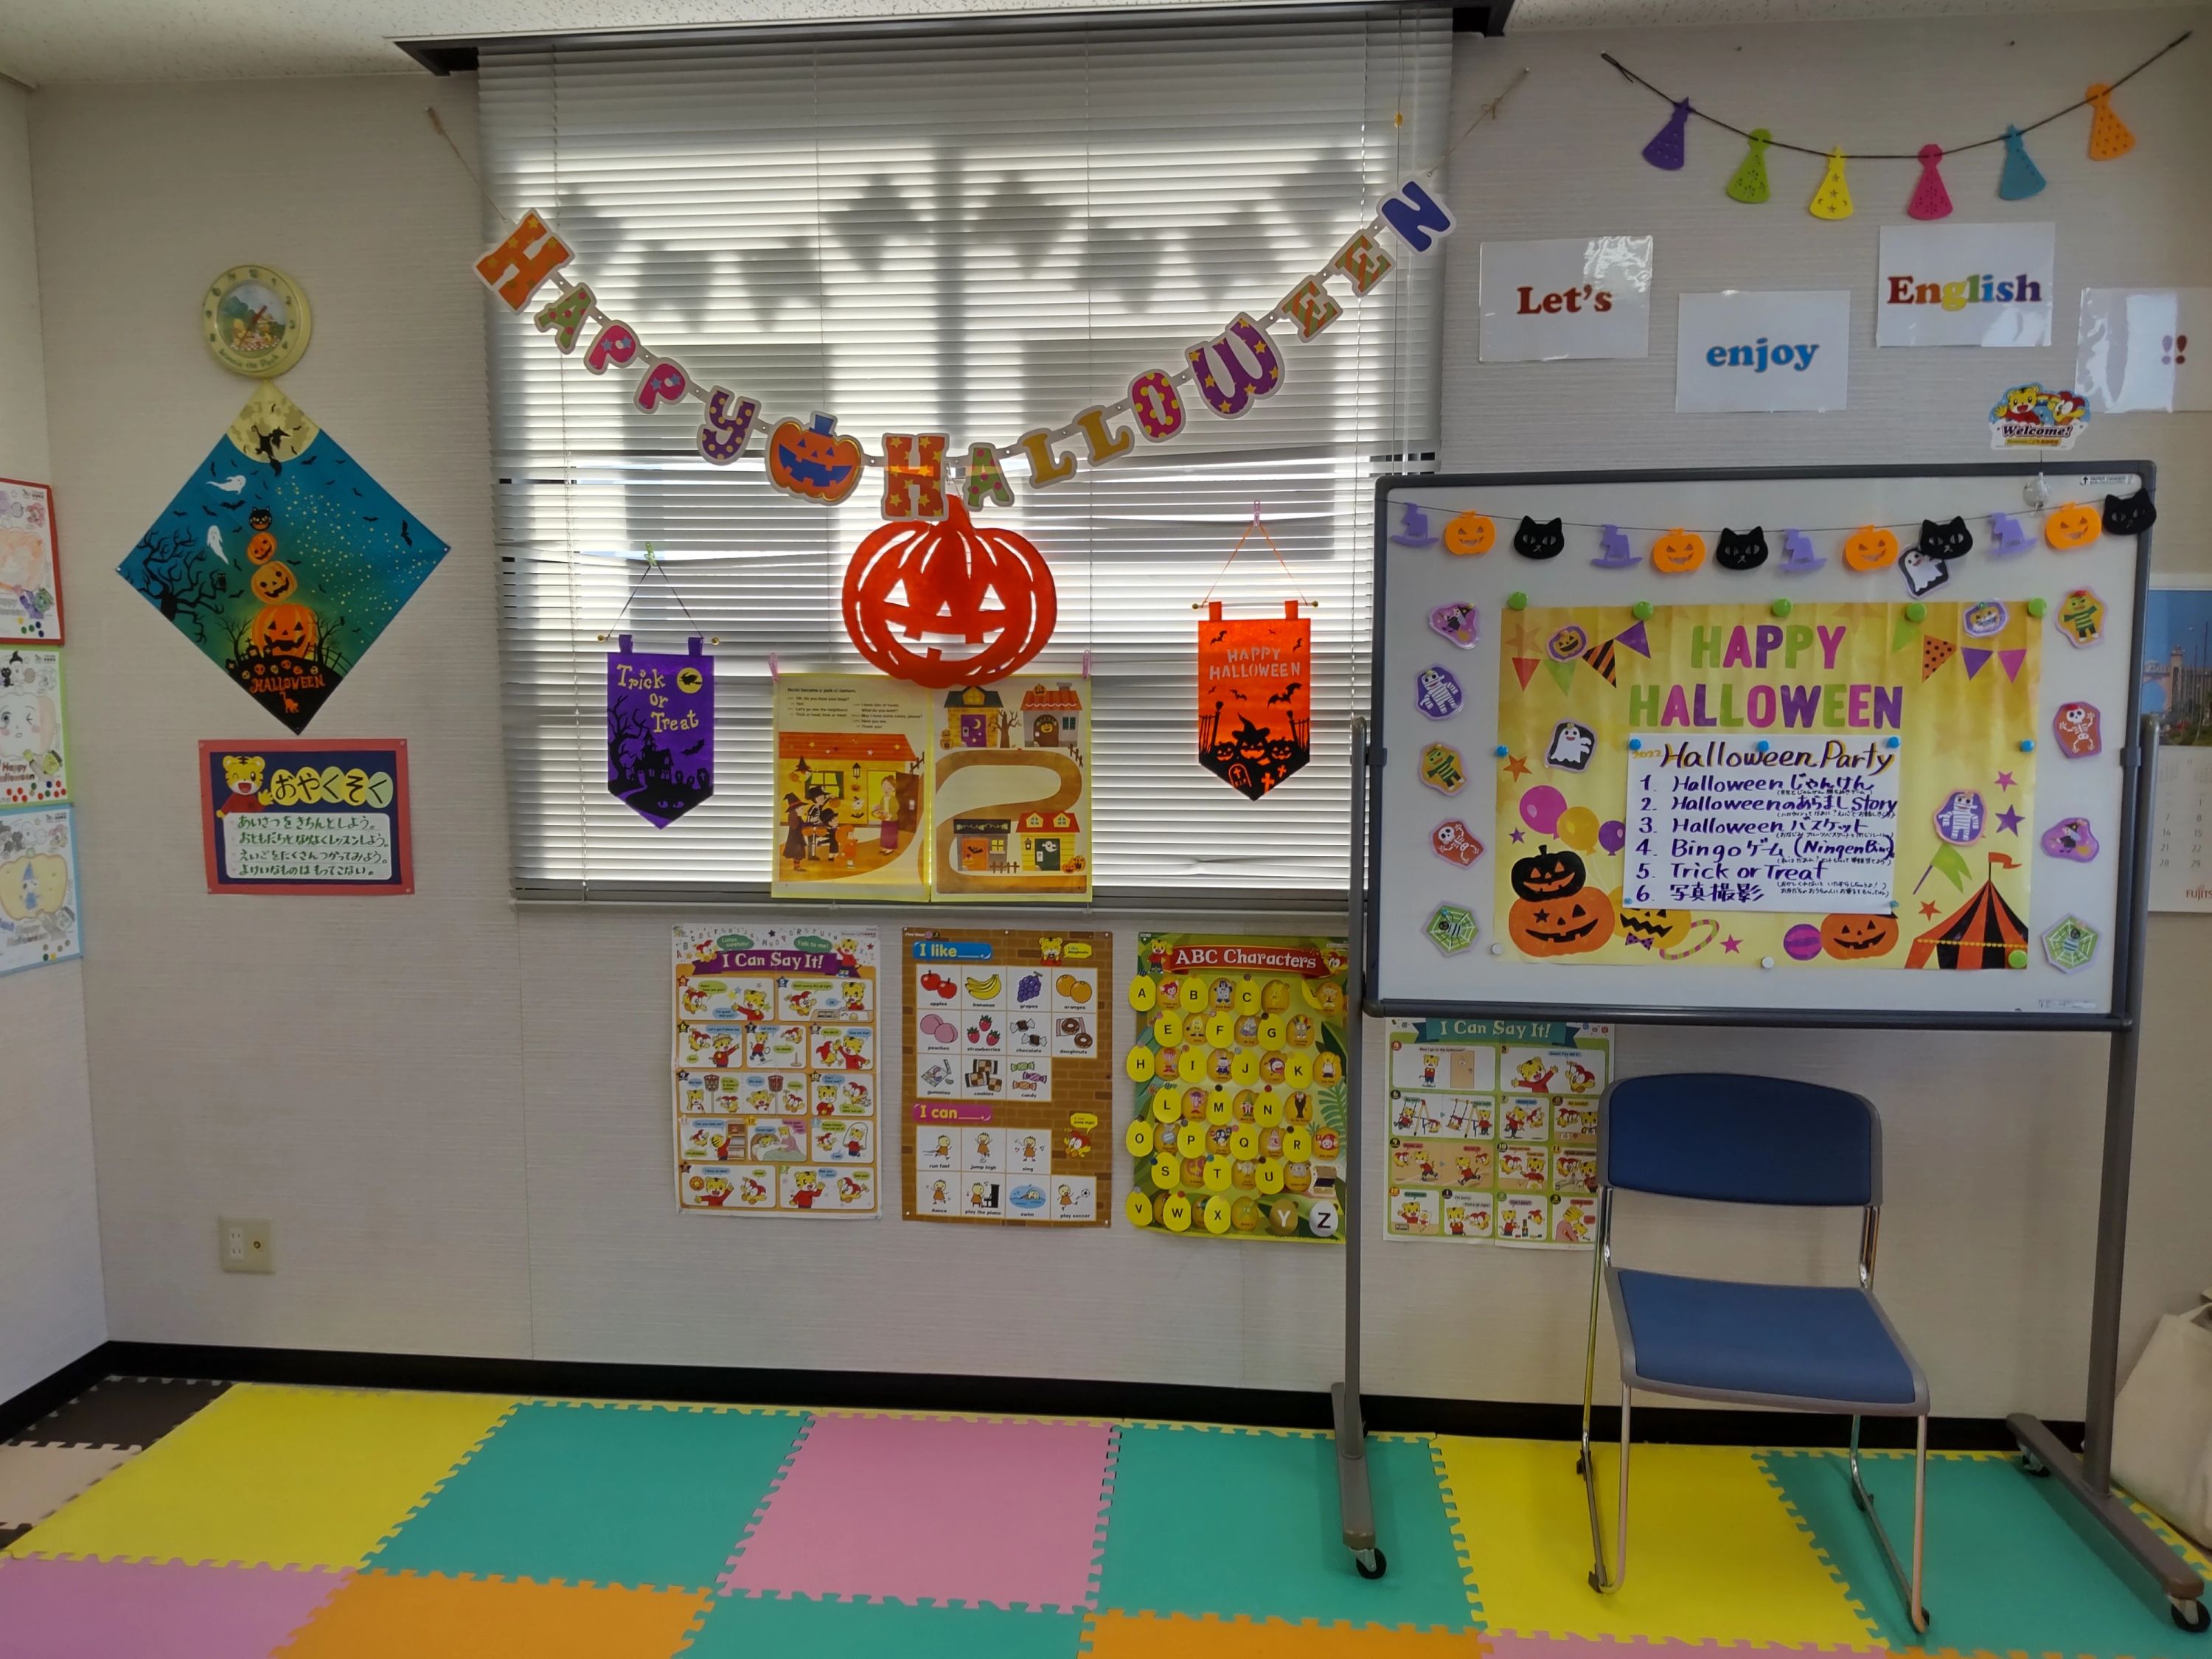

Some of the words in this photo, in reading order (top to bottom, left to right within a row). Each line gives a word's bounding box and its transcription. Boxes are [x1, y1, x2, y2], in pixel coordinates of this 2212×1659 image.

[1517, 285, 1613, 315] Let's
[1887, 274, 2042, 311] English
[476, 212, 757, 461] HAPPY
[884, 181, 1451, 518] HALLOWEEN
[1706, 338, 1820, 373] enjoy
[2002, 425, 2073, 437] Welcome!
[1227, 647, 1281, 663] HAPPY
[1692, 625, 1846, 669] HAPPY
[616, 664, 666, 690] Trick
[1209, 661, 1301, 681] HALLOWEEN
[250, 675, 326, 693] HALLOWEEN
[650, 693, 669, 708] or
[1629, 684, 1903, 728] HALLOWEEN
[650, 709, 699, 733] Treat
[1660, 741, 1818, 768] Halloween
[1820, 740, 1896, 776] Party
[275, 772, 388, 804] おやくそく
[1672, 775, 1784, 793] Halloween
[1672, 817, 1784, 834] Halloween
[1790, 816, 1869, 833] バスケット
[1672, 838, 1742, 863] Bingo
[1671, 863, 1729, 880] Trick
[1737, 867, 1761, 878] or
[1764, 860, 1829, 881] Treat
[1670, 882, 1764, 902] 写真撮影
[920, 943, 926, 956] I
[931, 943, 957, 957] like
[1175, 950, 1218, 964] ABC
[1223, 948, 1317, 969] Characters
[723, 953, 730, 967] I
[735, 953, 765, 967] Can
[771, 951, 801, 970] Say
[804, 953, 824, 969] It!
[1138, 988, 1146, 998] A
[1189, 990, 1198, 1001] B
[1242, 992, 1251, 1003] C
[1164, 1025, 1172, 1034] E
[1217, 1026, 1224, 1035] F
[1267, 1028, 1276, 1038] G
[1441, 1020, 1447, 1036] I
[1454, 1020, 1486, 1034] Can
[1492, 1020, 1524, 1040] Say
[1531, 1023, 1551, 1038] It!
[1136, 1059, 1145, 1069] H
[1191, 1060, 1194, 1071] I
[1242, 1063, 1249, 1074] J
[1294, 1066, 1303, 1077] K
[920, 1105, 927, 1118] I
[931, 1107, 958, 1119] can
[1164, 1100, 1171, 1110] L
[1214, 1102, 1224, 1113] M
[1264, 1105, 1273, 1116] N
[1135, 1133, 1144, 1144] O
[1187, 1135, 1195, 1145] P
[1239, 1138, 1249, 1148] Q
[1293, 1140, 1301, 1150] R
[1161, 1166, 1169, 1177] S
[1214, 1169, 1222, 1179] T
[1265, 1172, 1274, 1182] U
[1135, 1204, 1143, 1214] V
[1172, 1208, 1183, 1219] W
[1214, 1210, 1222, 1221] X
[1277, 1209, 1291, 1228] Y
[1317, 1212, 1332, 1229] Z
